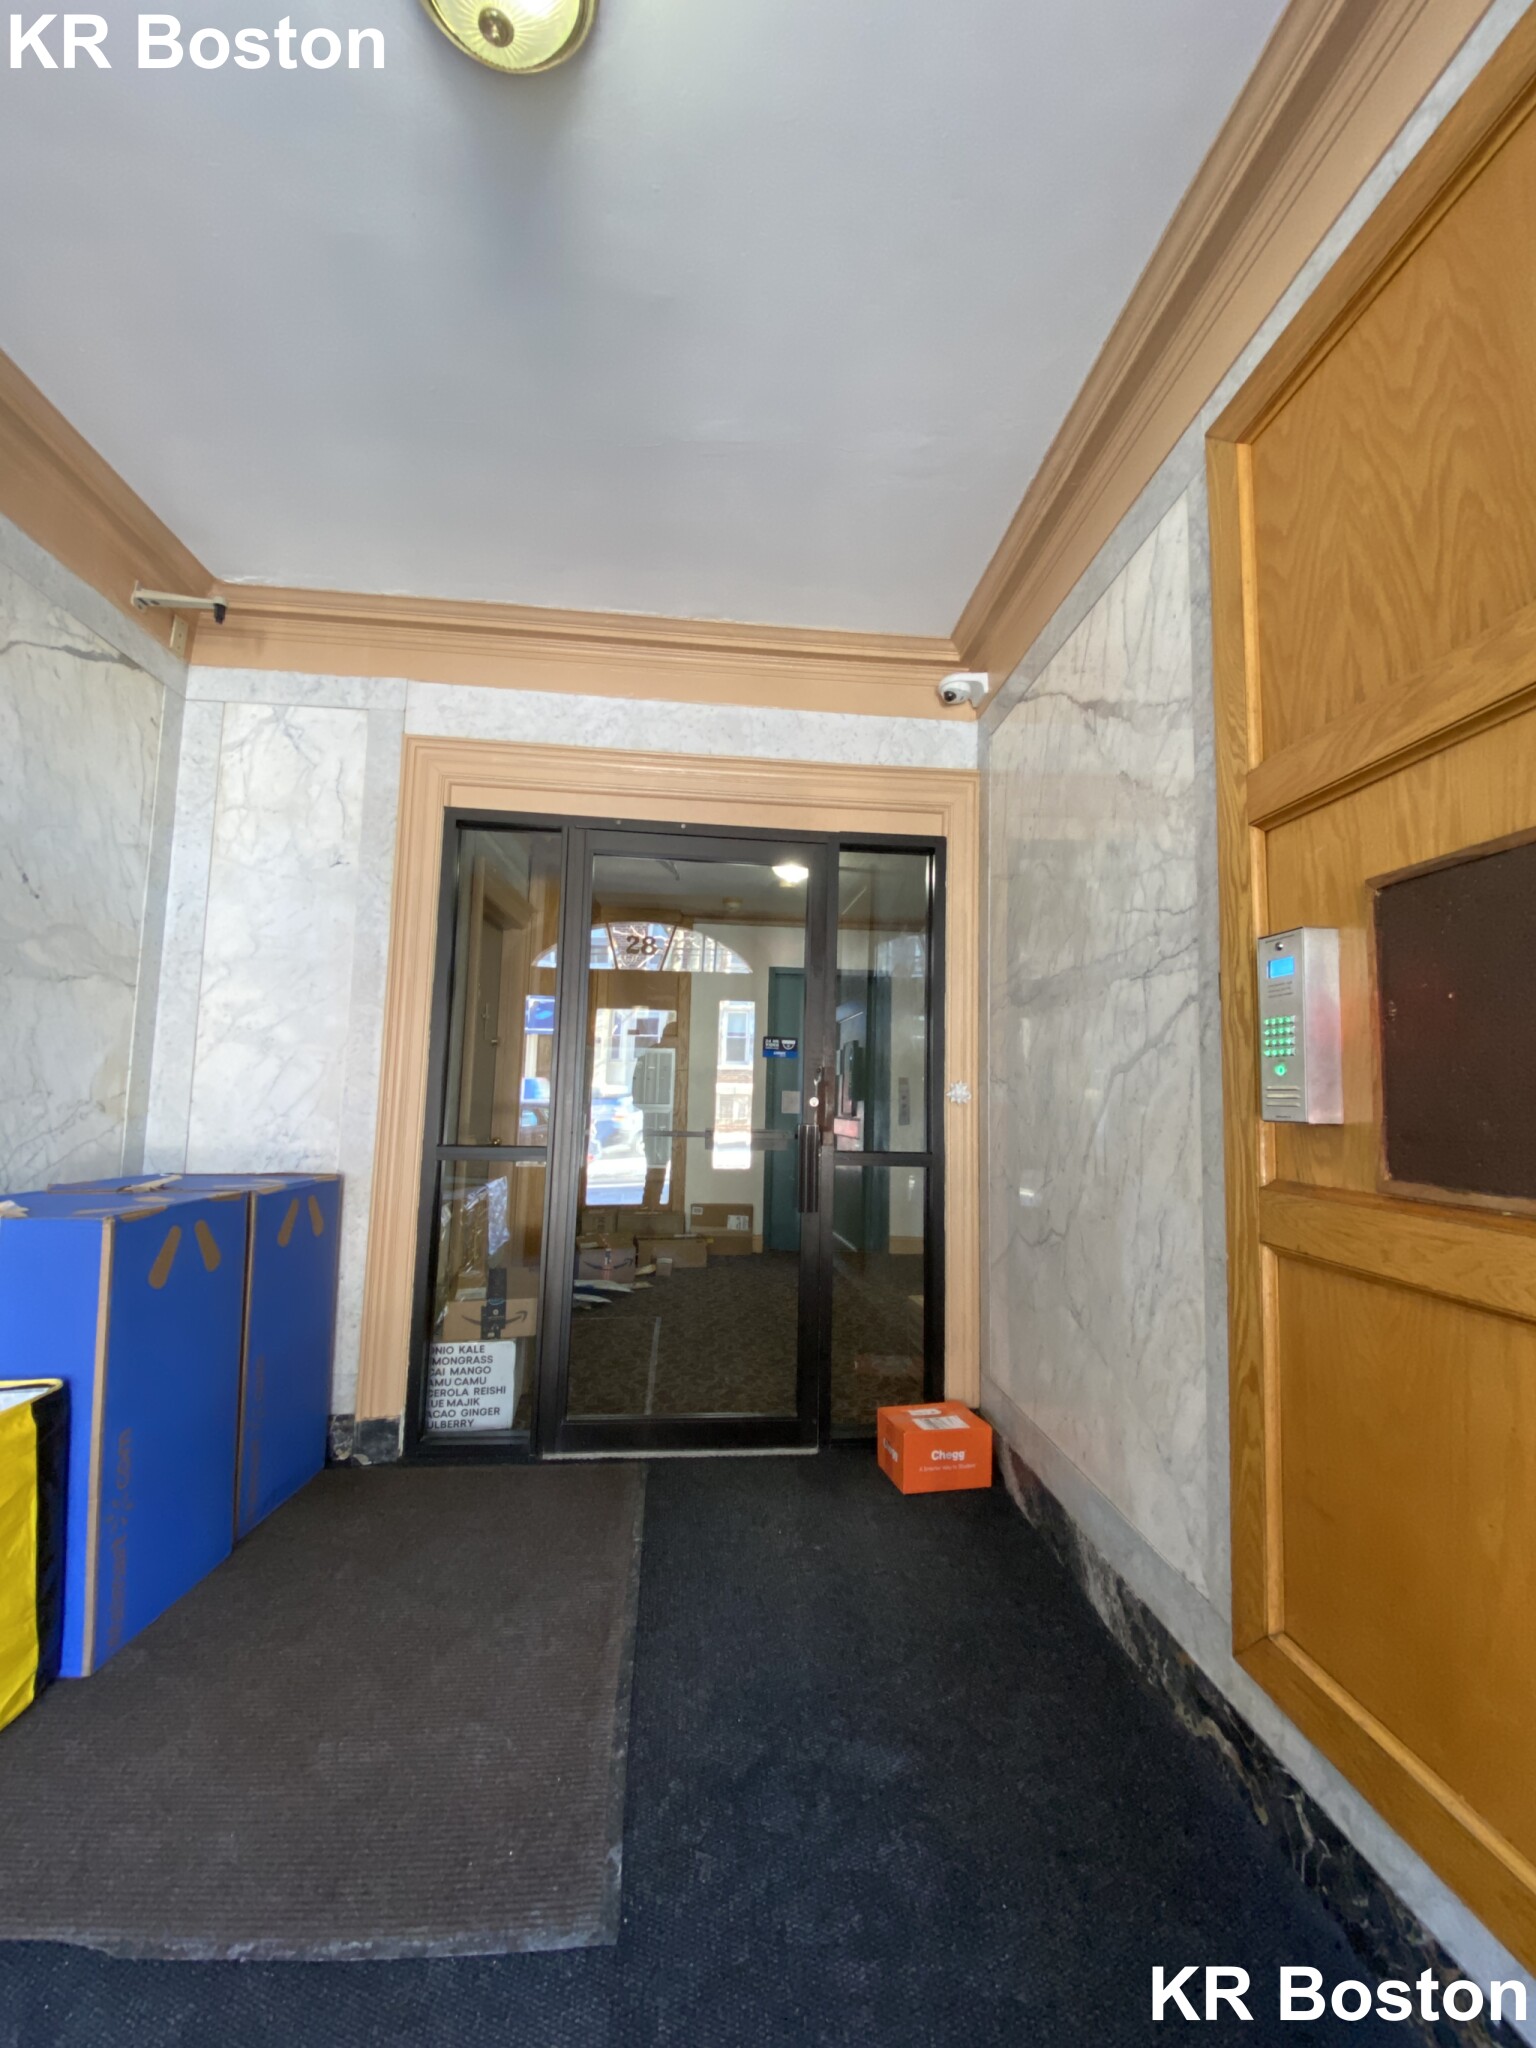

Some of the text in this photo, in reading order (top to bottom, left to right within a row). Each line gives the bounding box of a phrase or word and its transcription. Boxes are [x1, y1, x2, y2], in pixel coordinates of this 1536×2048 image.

[626, 935, 657, 955] 28
[459, 1345, 485, 1354] KALE
[449, 1366, 492, 1376] MANGO
[454, 1377, 487, 1386] CAMU
[473, 1386, 506, 1396] REISHI
[446, 1398, 480, 1407] MAJIK
[461, 1407, 500, 1417] GINGER
[931, 1449, 965, 1461] Chegg
